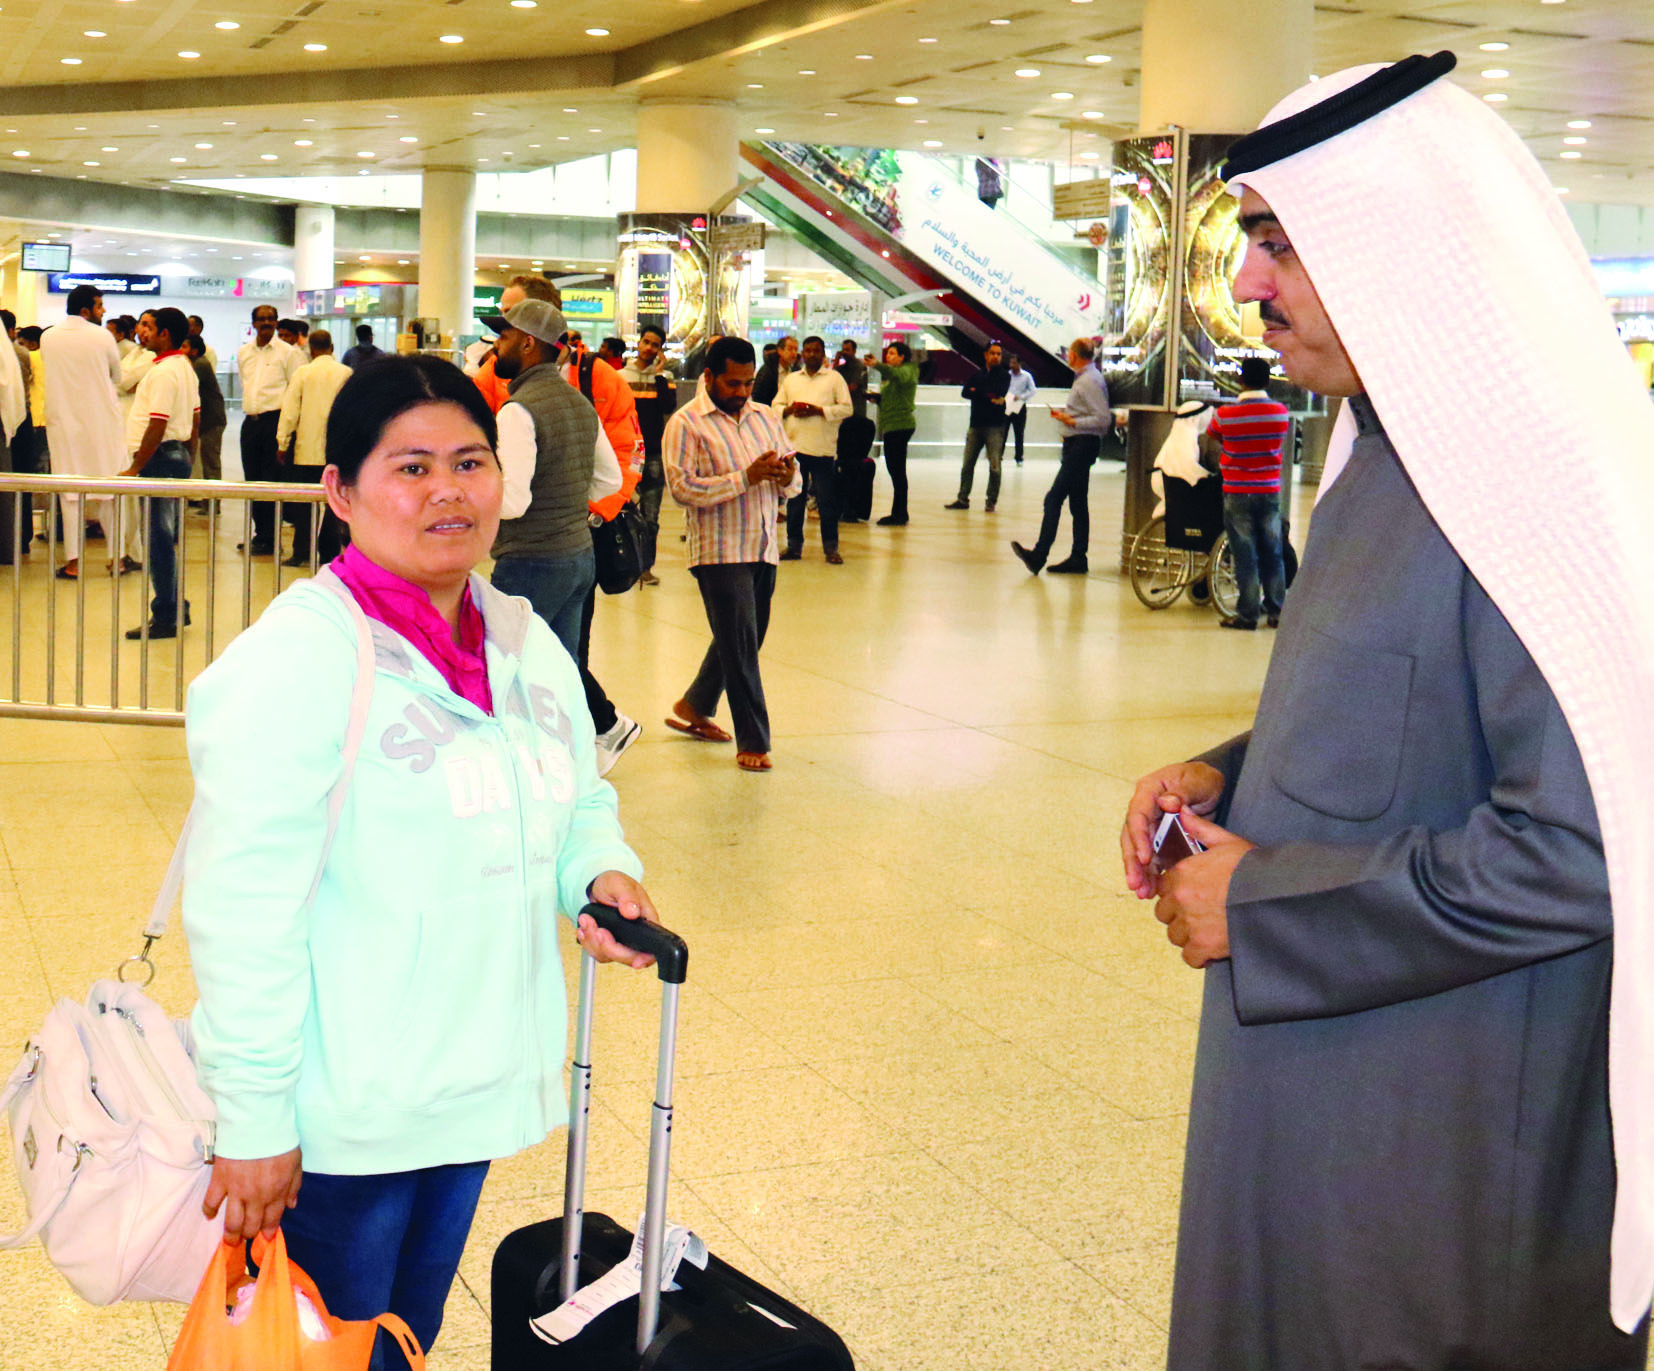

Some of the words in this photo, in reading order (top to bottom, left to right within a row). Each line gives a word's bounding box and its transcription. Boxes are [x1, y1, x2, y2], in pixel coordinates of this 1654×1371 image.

[921, 218, 959, 248] والسلام
[961, 242, 991, 268] المحبة
[933, 243, 988, 289] WELCOME
[987, 284, 1002, 300] TO
[1002, 296, 1044, 329] KUWAIT
[987, 265, 1014, 285] أرض
[1024, 294, 1043, 311] بكم
[1043, 304, 1065, 326] مرحبا
